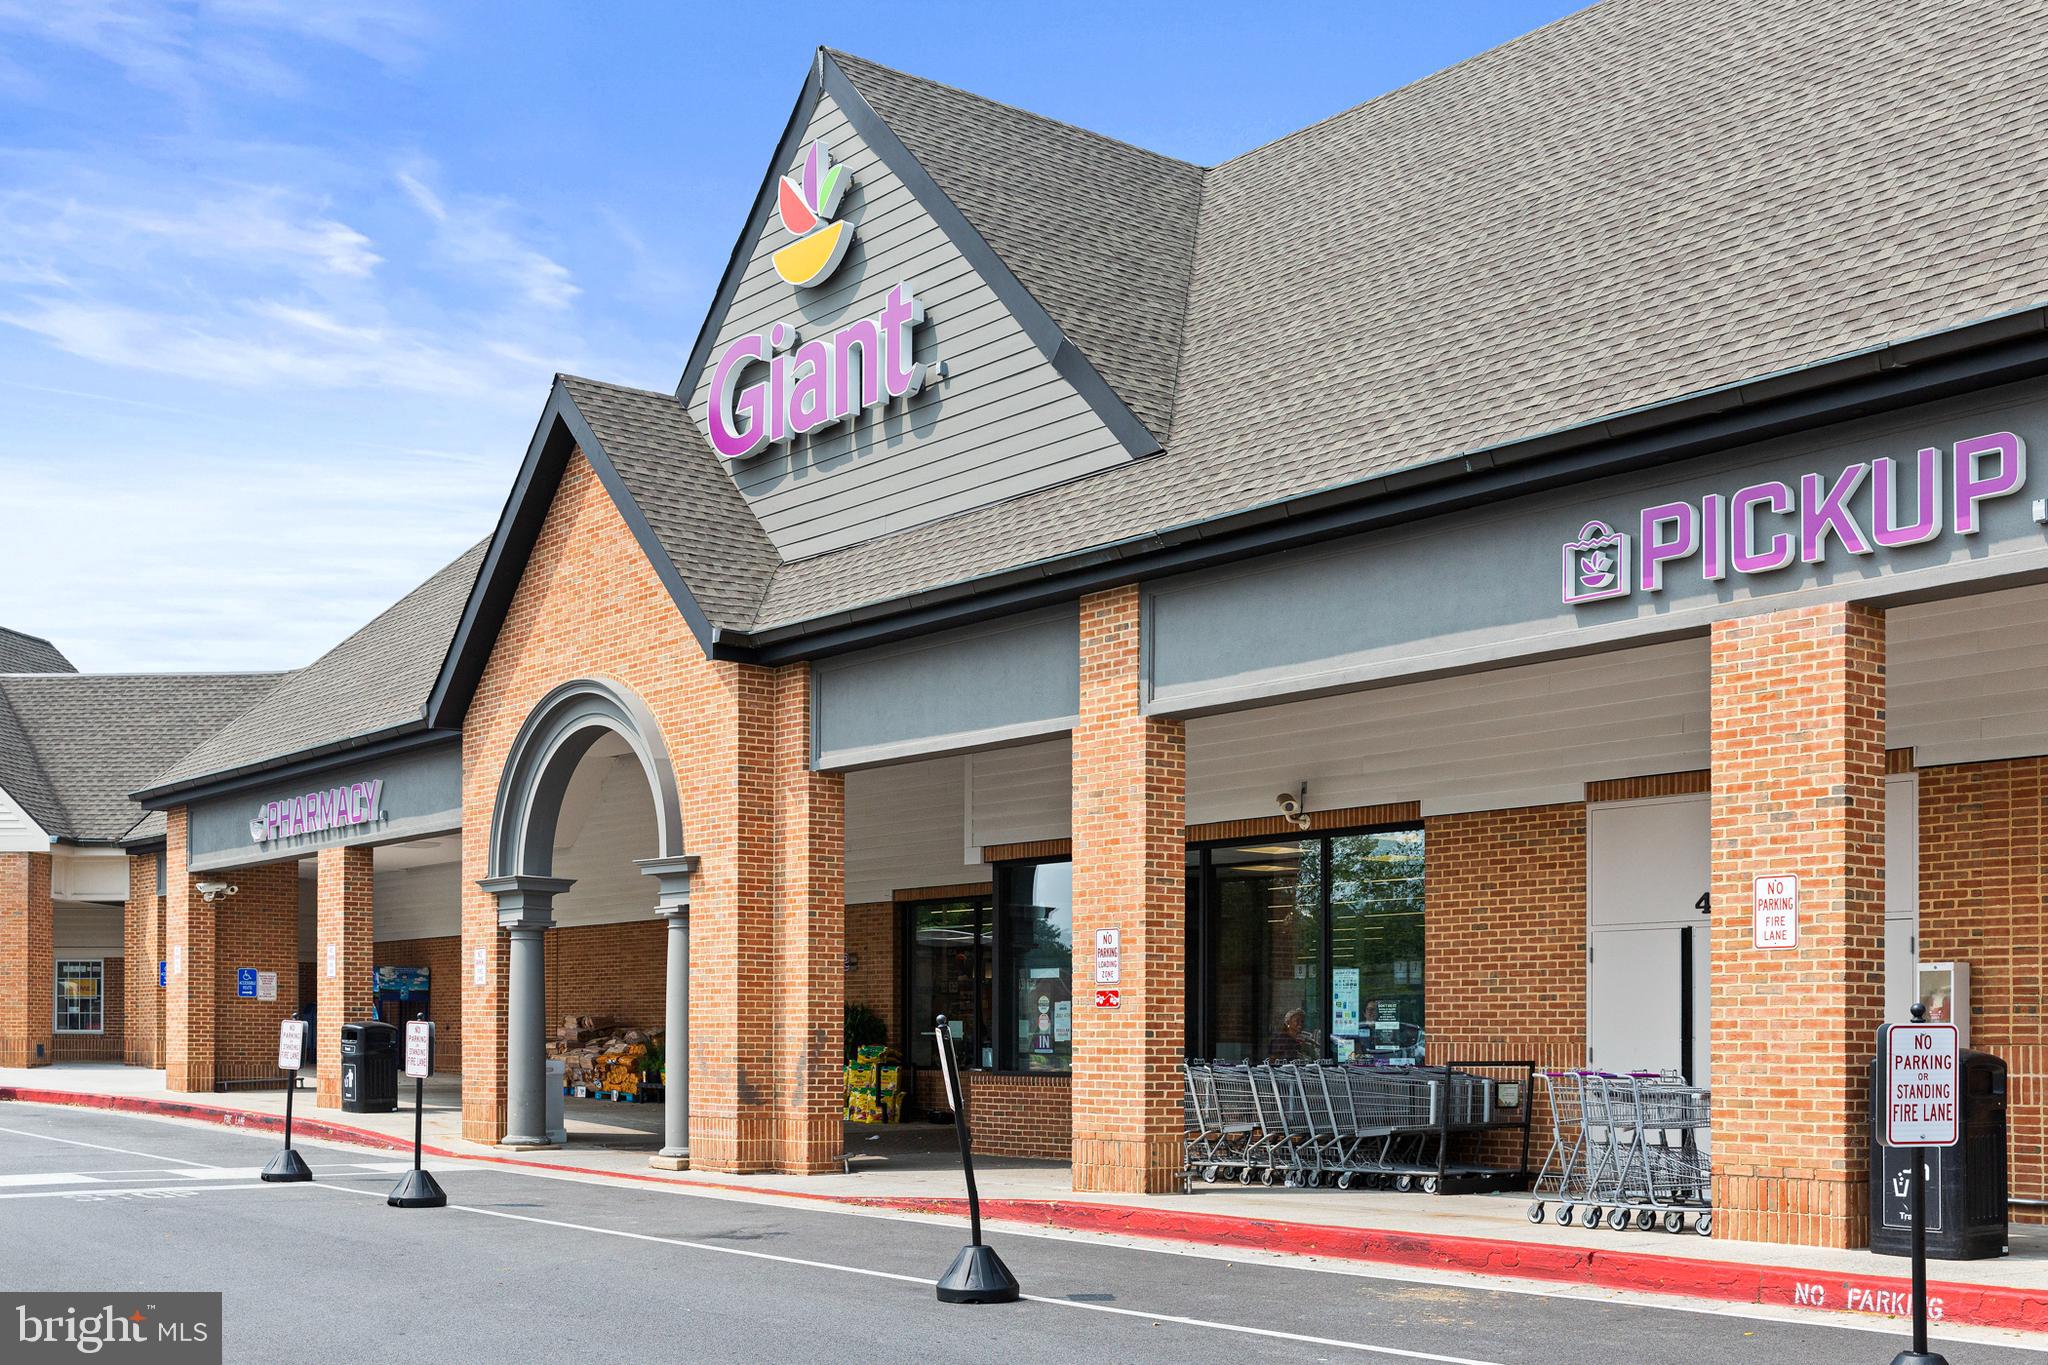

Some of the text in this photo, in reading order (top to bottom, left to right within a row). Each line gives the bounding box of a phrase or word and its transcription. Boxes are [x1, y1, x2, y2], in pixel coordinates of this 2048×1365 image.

[707, 281, 924, 457] Giant
[1640, 432, 2026, 591] PICKUP
[267, 779, 383, 840] PHARMACY
[1768, 882, 1783, 894] NO
[1695, 892, 1711, 914] 4
[1758, 898, 1793, 911] PARKING
[1766, 916, 1786, 926] FIRE
[1103, 934, 1112, 944] NO
[1764, 930, 1787, 940] LANE
[1098, 947, 1118, 958] PARKING
[1040, 1036, 1050, 1048] IN
[1914, 1035, 1932, 1049] NO
[1895, 1055, 1952, 1070] PARKING
[1897, 1084, 1950, 1099] STANDING
[1893, 1104, 1952, 1122] FIRE LANE
[1794, 1282, 1944, 1321] NO PARKIG
